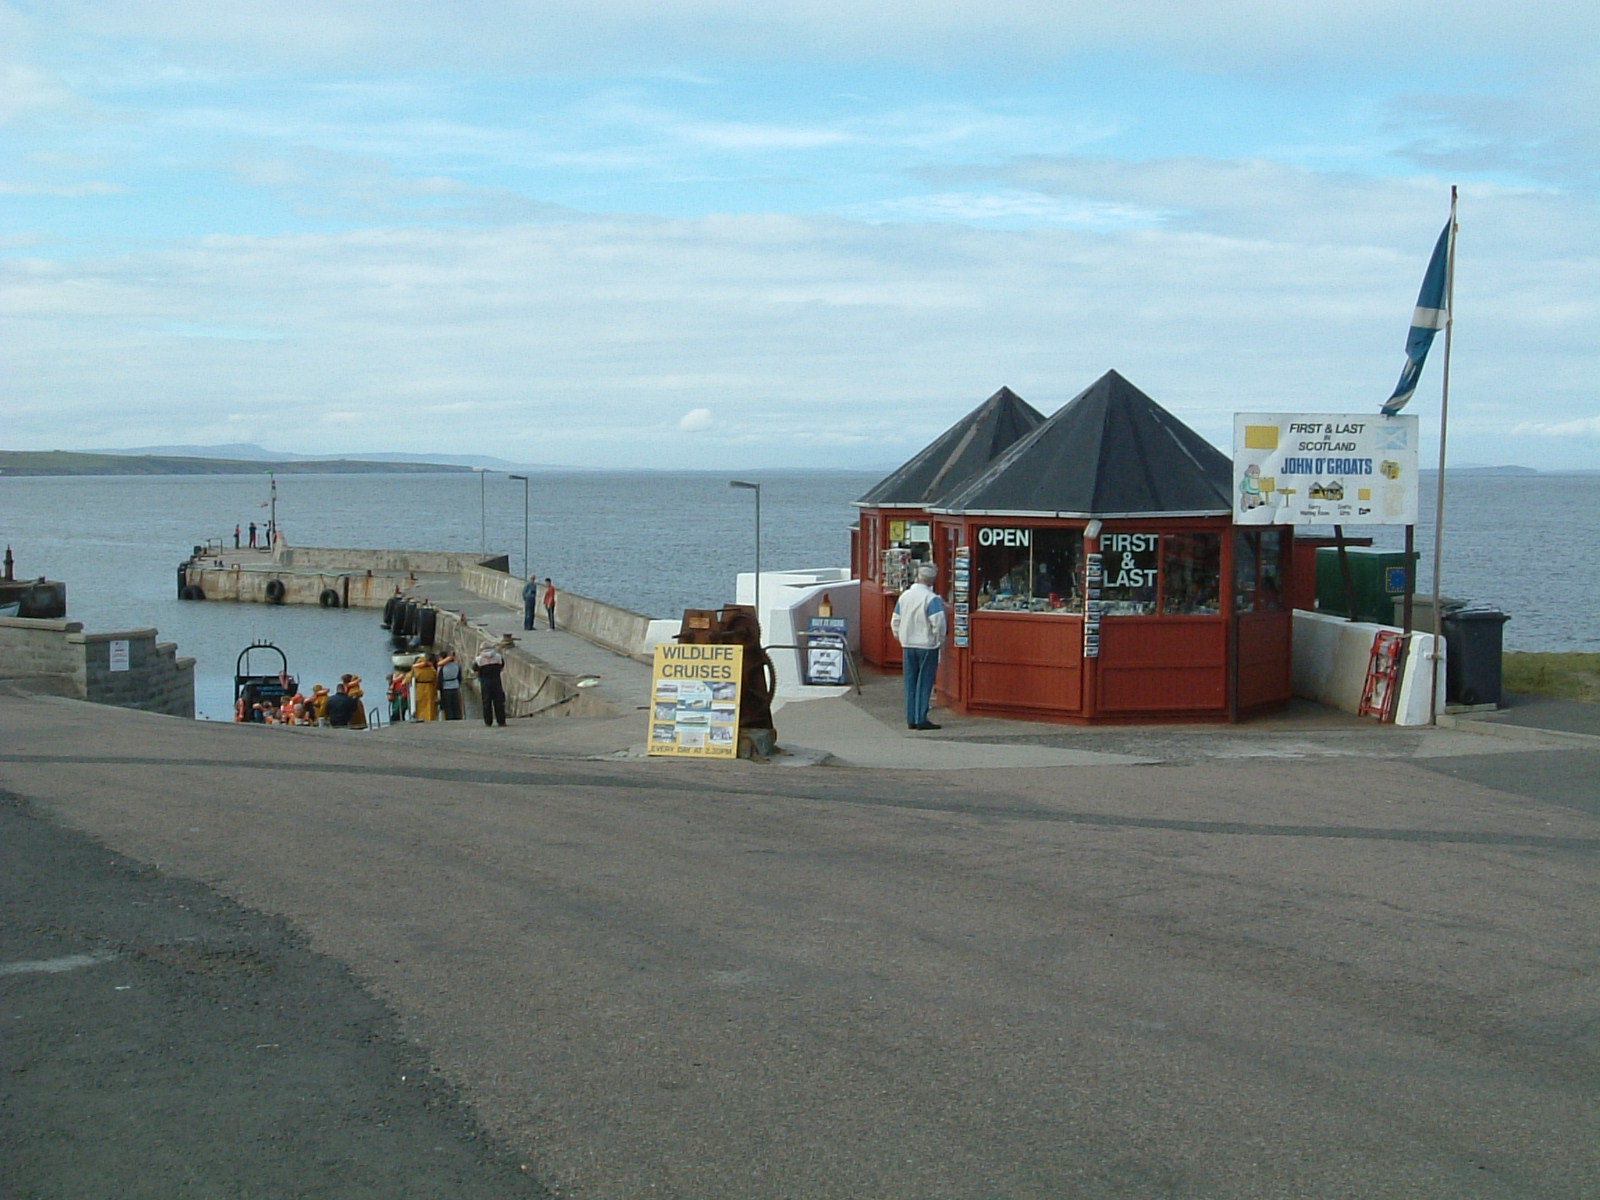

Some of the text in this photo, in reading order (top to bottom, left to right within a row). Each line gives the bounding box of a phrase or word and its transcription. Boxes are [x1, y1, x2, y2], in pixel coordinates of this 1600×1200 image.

[1289, 423, 1366, 434] FIRST & LAST
[1298, 442, 1357, 451] SCOTLAND
[1281, 457, 1313, 475] JOHN
[978, 528, 1029, 547] OPEN
[1100, 534, 1159, 552] FIRST
[1121, 552, 1135, 569] &
[1103, 569, 1157, 587] LAST
[662, 646, 733, 660] WILDLIFE
[662, 664, 732, 679] CRUISES
[651, 745, 674, 753] EVERY
[694, 746, 703, 754] AT
